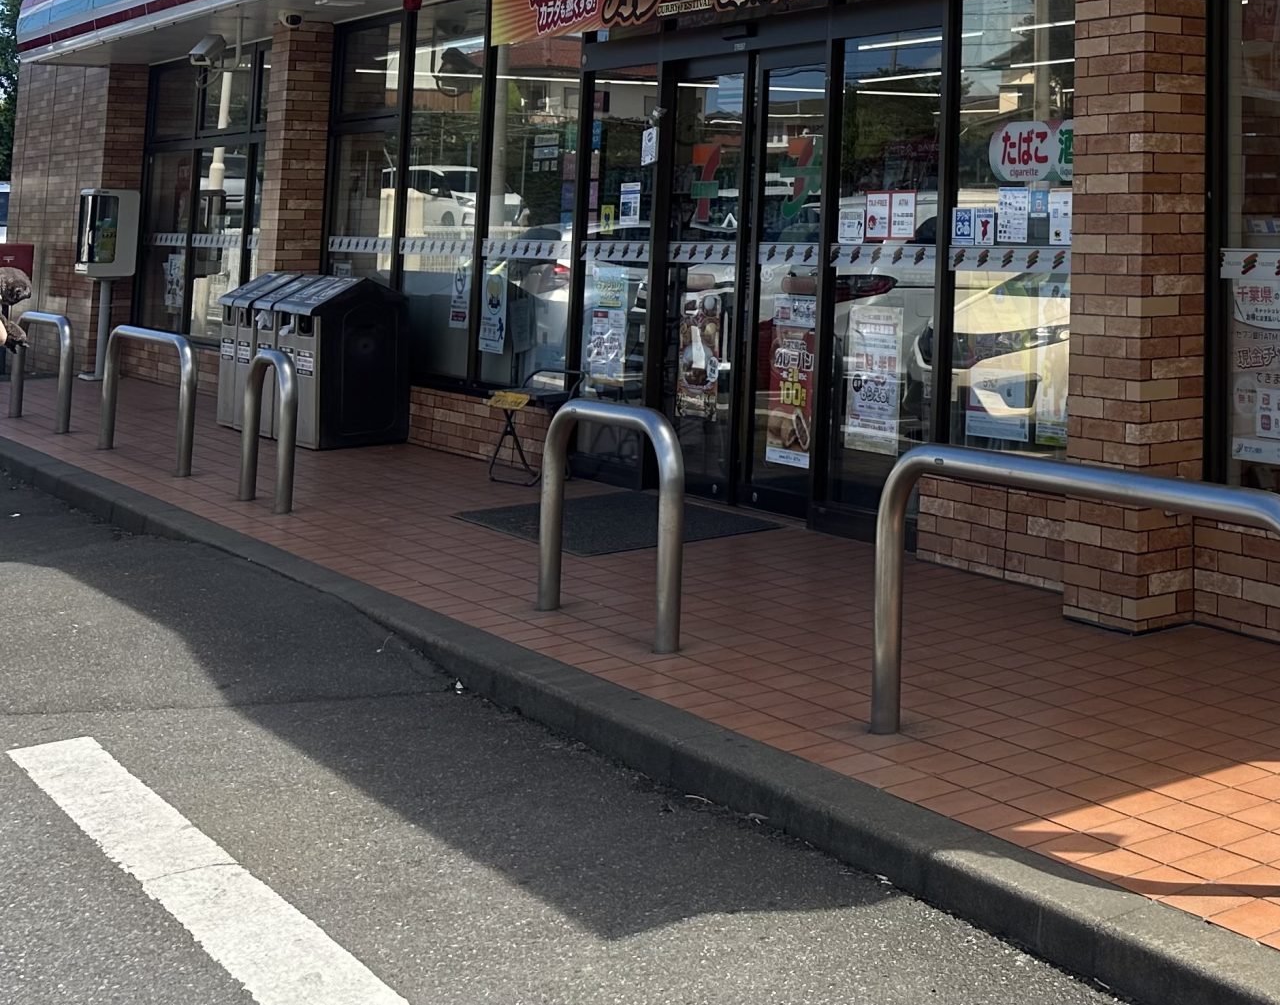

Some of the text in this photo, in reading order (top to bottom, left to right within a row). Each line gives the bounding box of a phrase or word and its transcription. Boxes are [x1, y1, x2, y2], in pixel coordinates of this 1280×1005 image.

[657, 1, 678, 15] CURRY
[1001, 128, 1048, 165] たばこ
[1010, 166, 1073, 178] cigarette liqu
[898, 198, 909, 206] ATM
[774, 348, 814, 371] カレーパン
